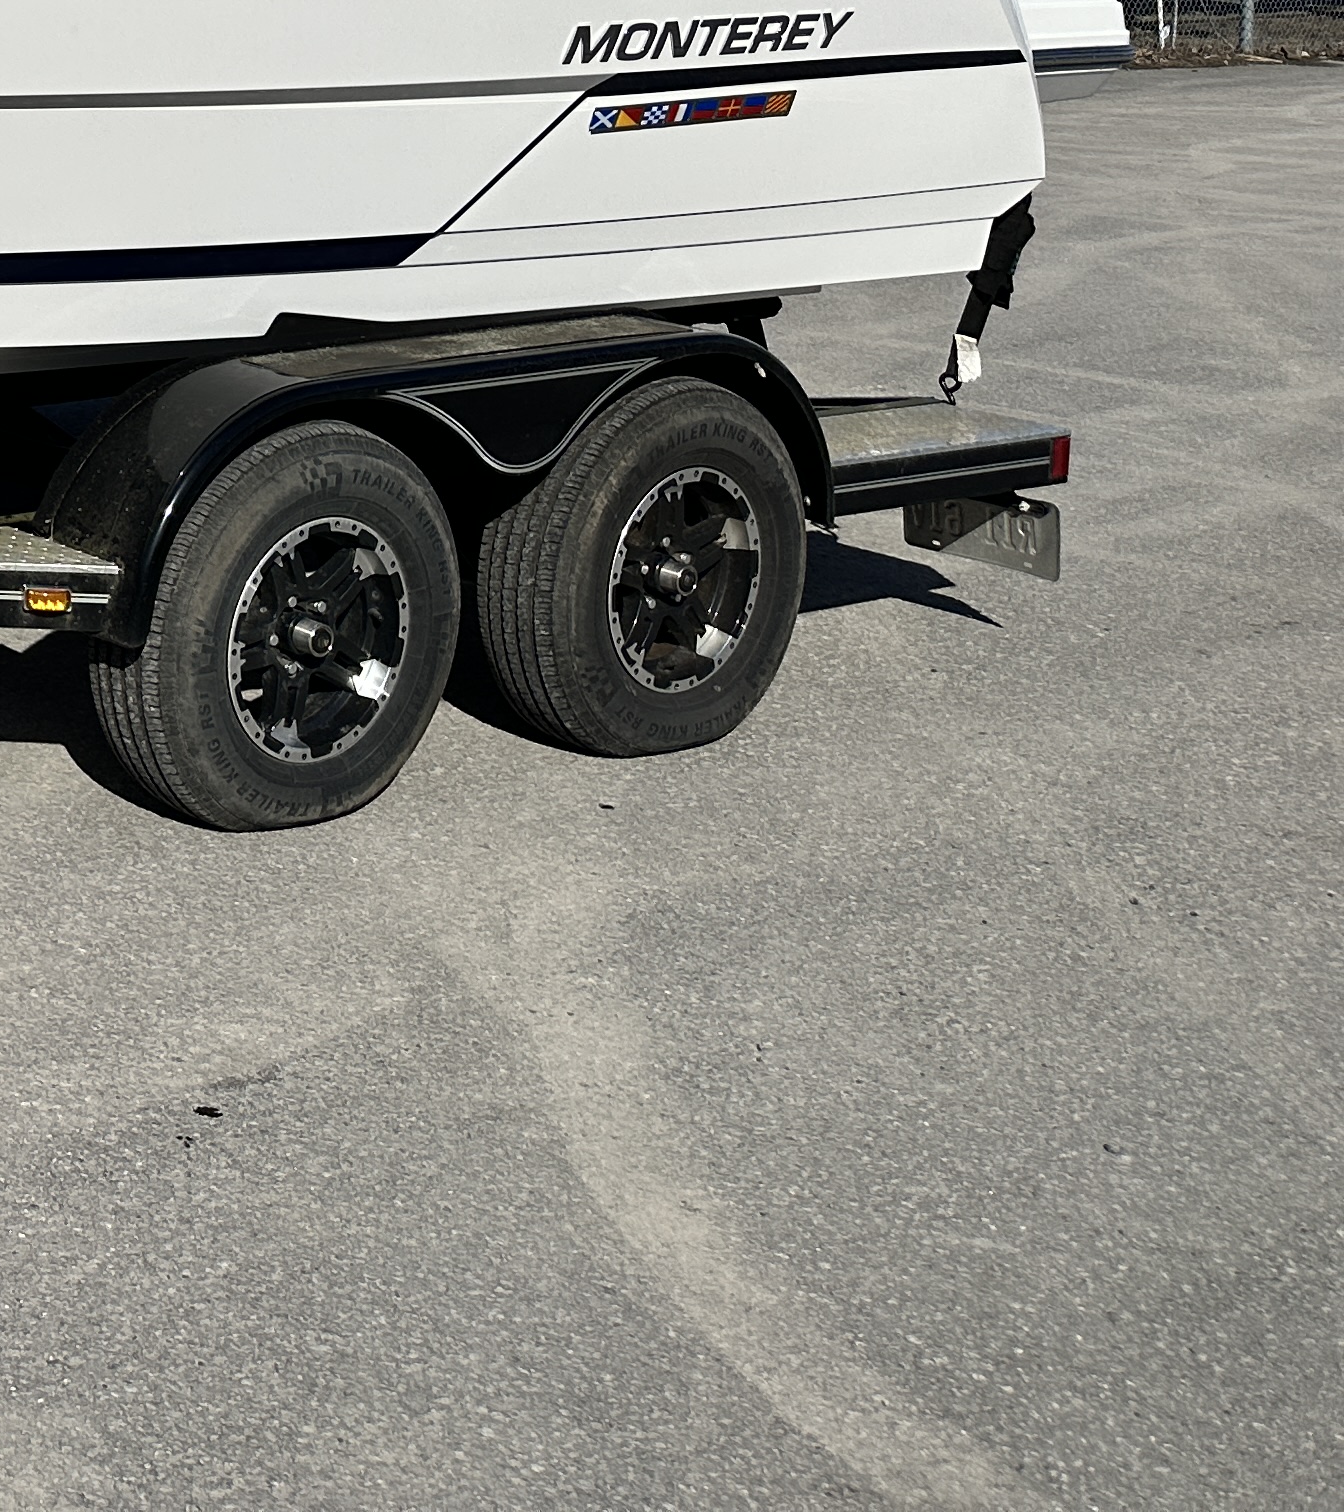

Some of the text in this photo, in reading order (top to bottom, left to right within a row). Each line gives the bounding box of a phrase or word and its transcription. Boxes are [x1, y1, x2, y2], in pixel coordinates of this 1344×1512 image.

[562, 10, 856, 65] MONTEREY
[712, 422, 747, 444] KING
[352, 469, 415, 510] TRAILER
[415, 506, 443, 550] KING
[646, 722, 688, 740] KING
[207, 738, 239, 784] KING
[236, 781, 311, 817] TRAILER
